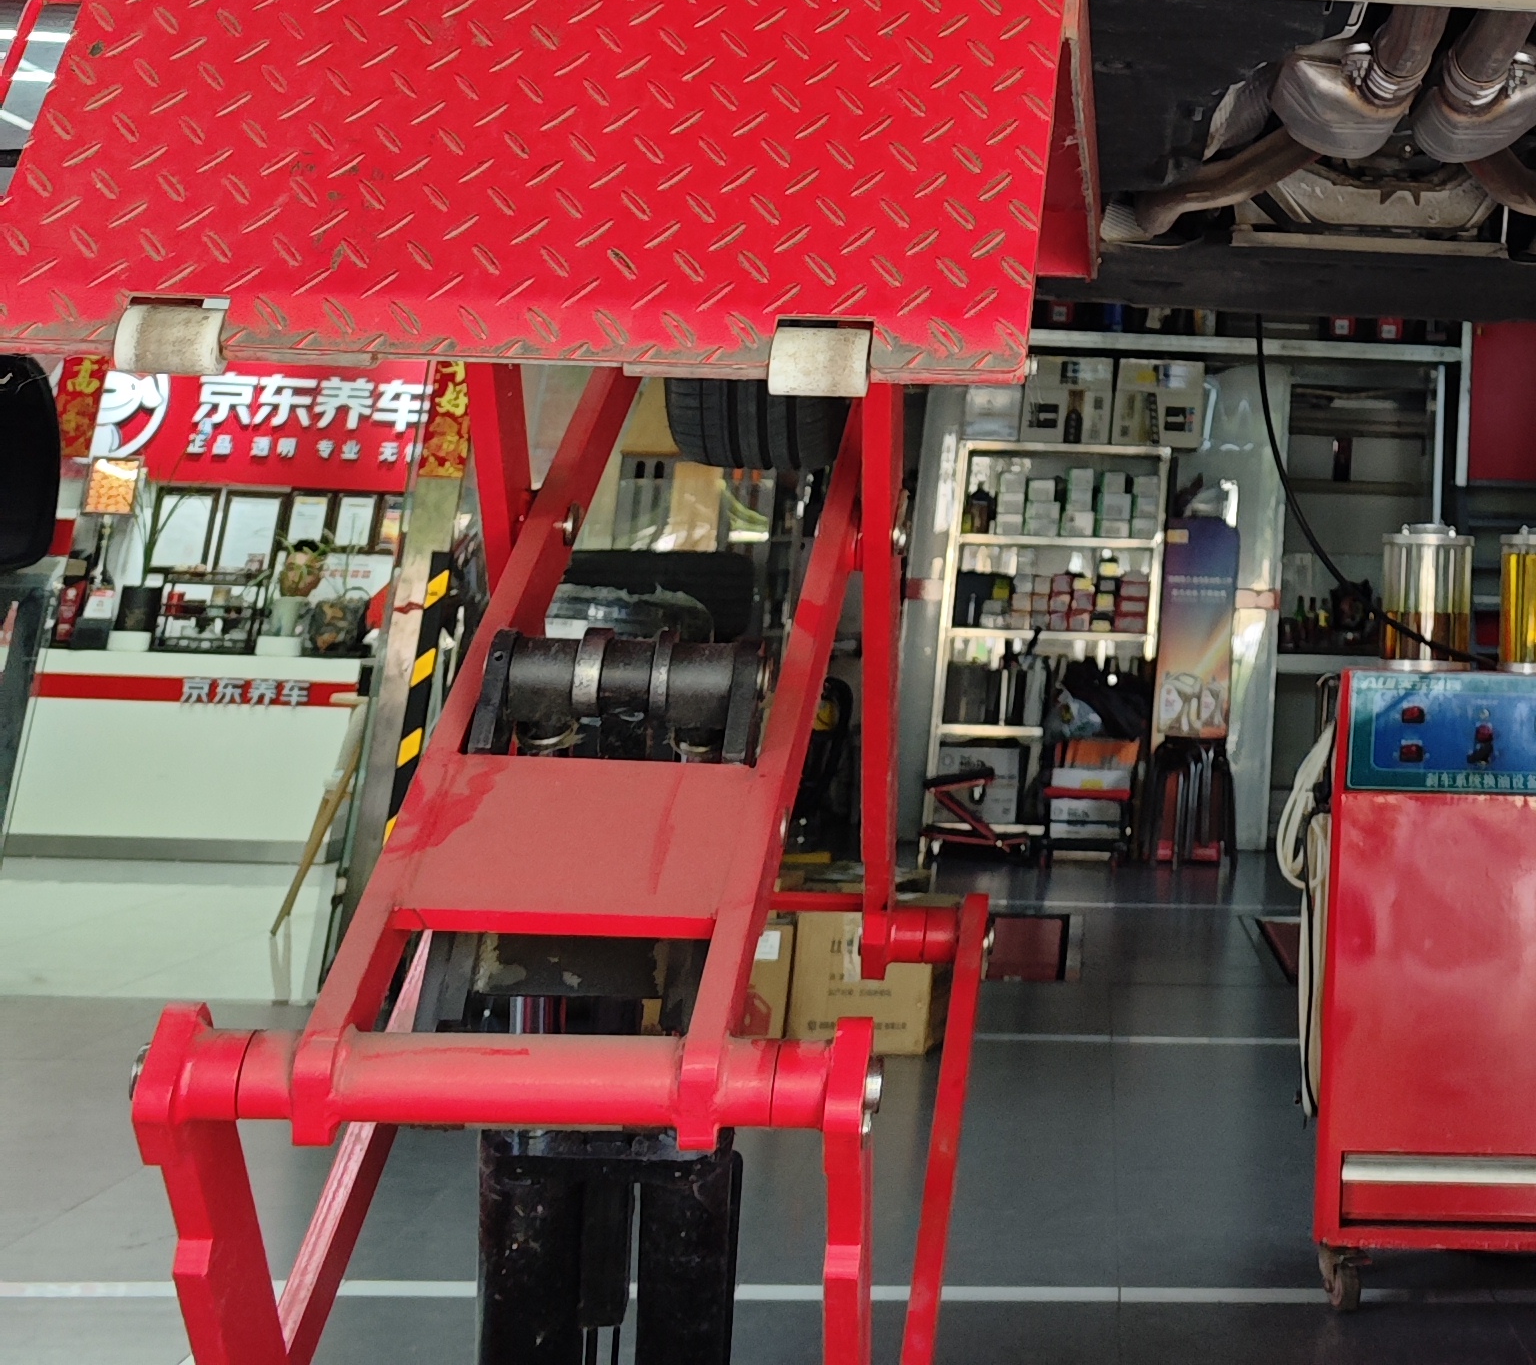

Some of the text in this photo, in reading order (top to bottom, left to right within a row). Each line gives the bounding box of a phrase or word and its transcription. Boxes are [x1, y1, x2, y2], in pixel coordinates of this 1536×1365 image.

[193, 373, 435, 433] 京东养车
[316, 439, 361, 461] 专业
[180, 678, 311, 707] 京东养车
